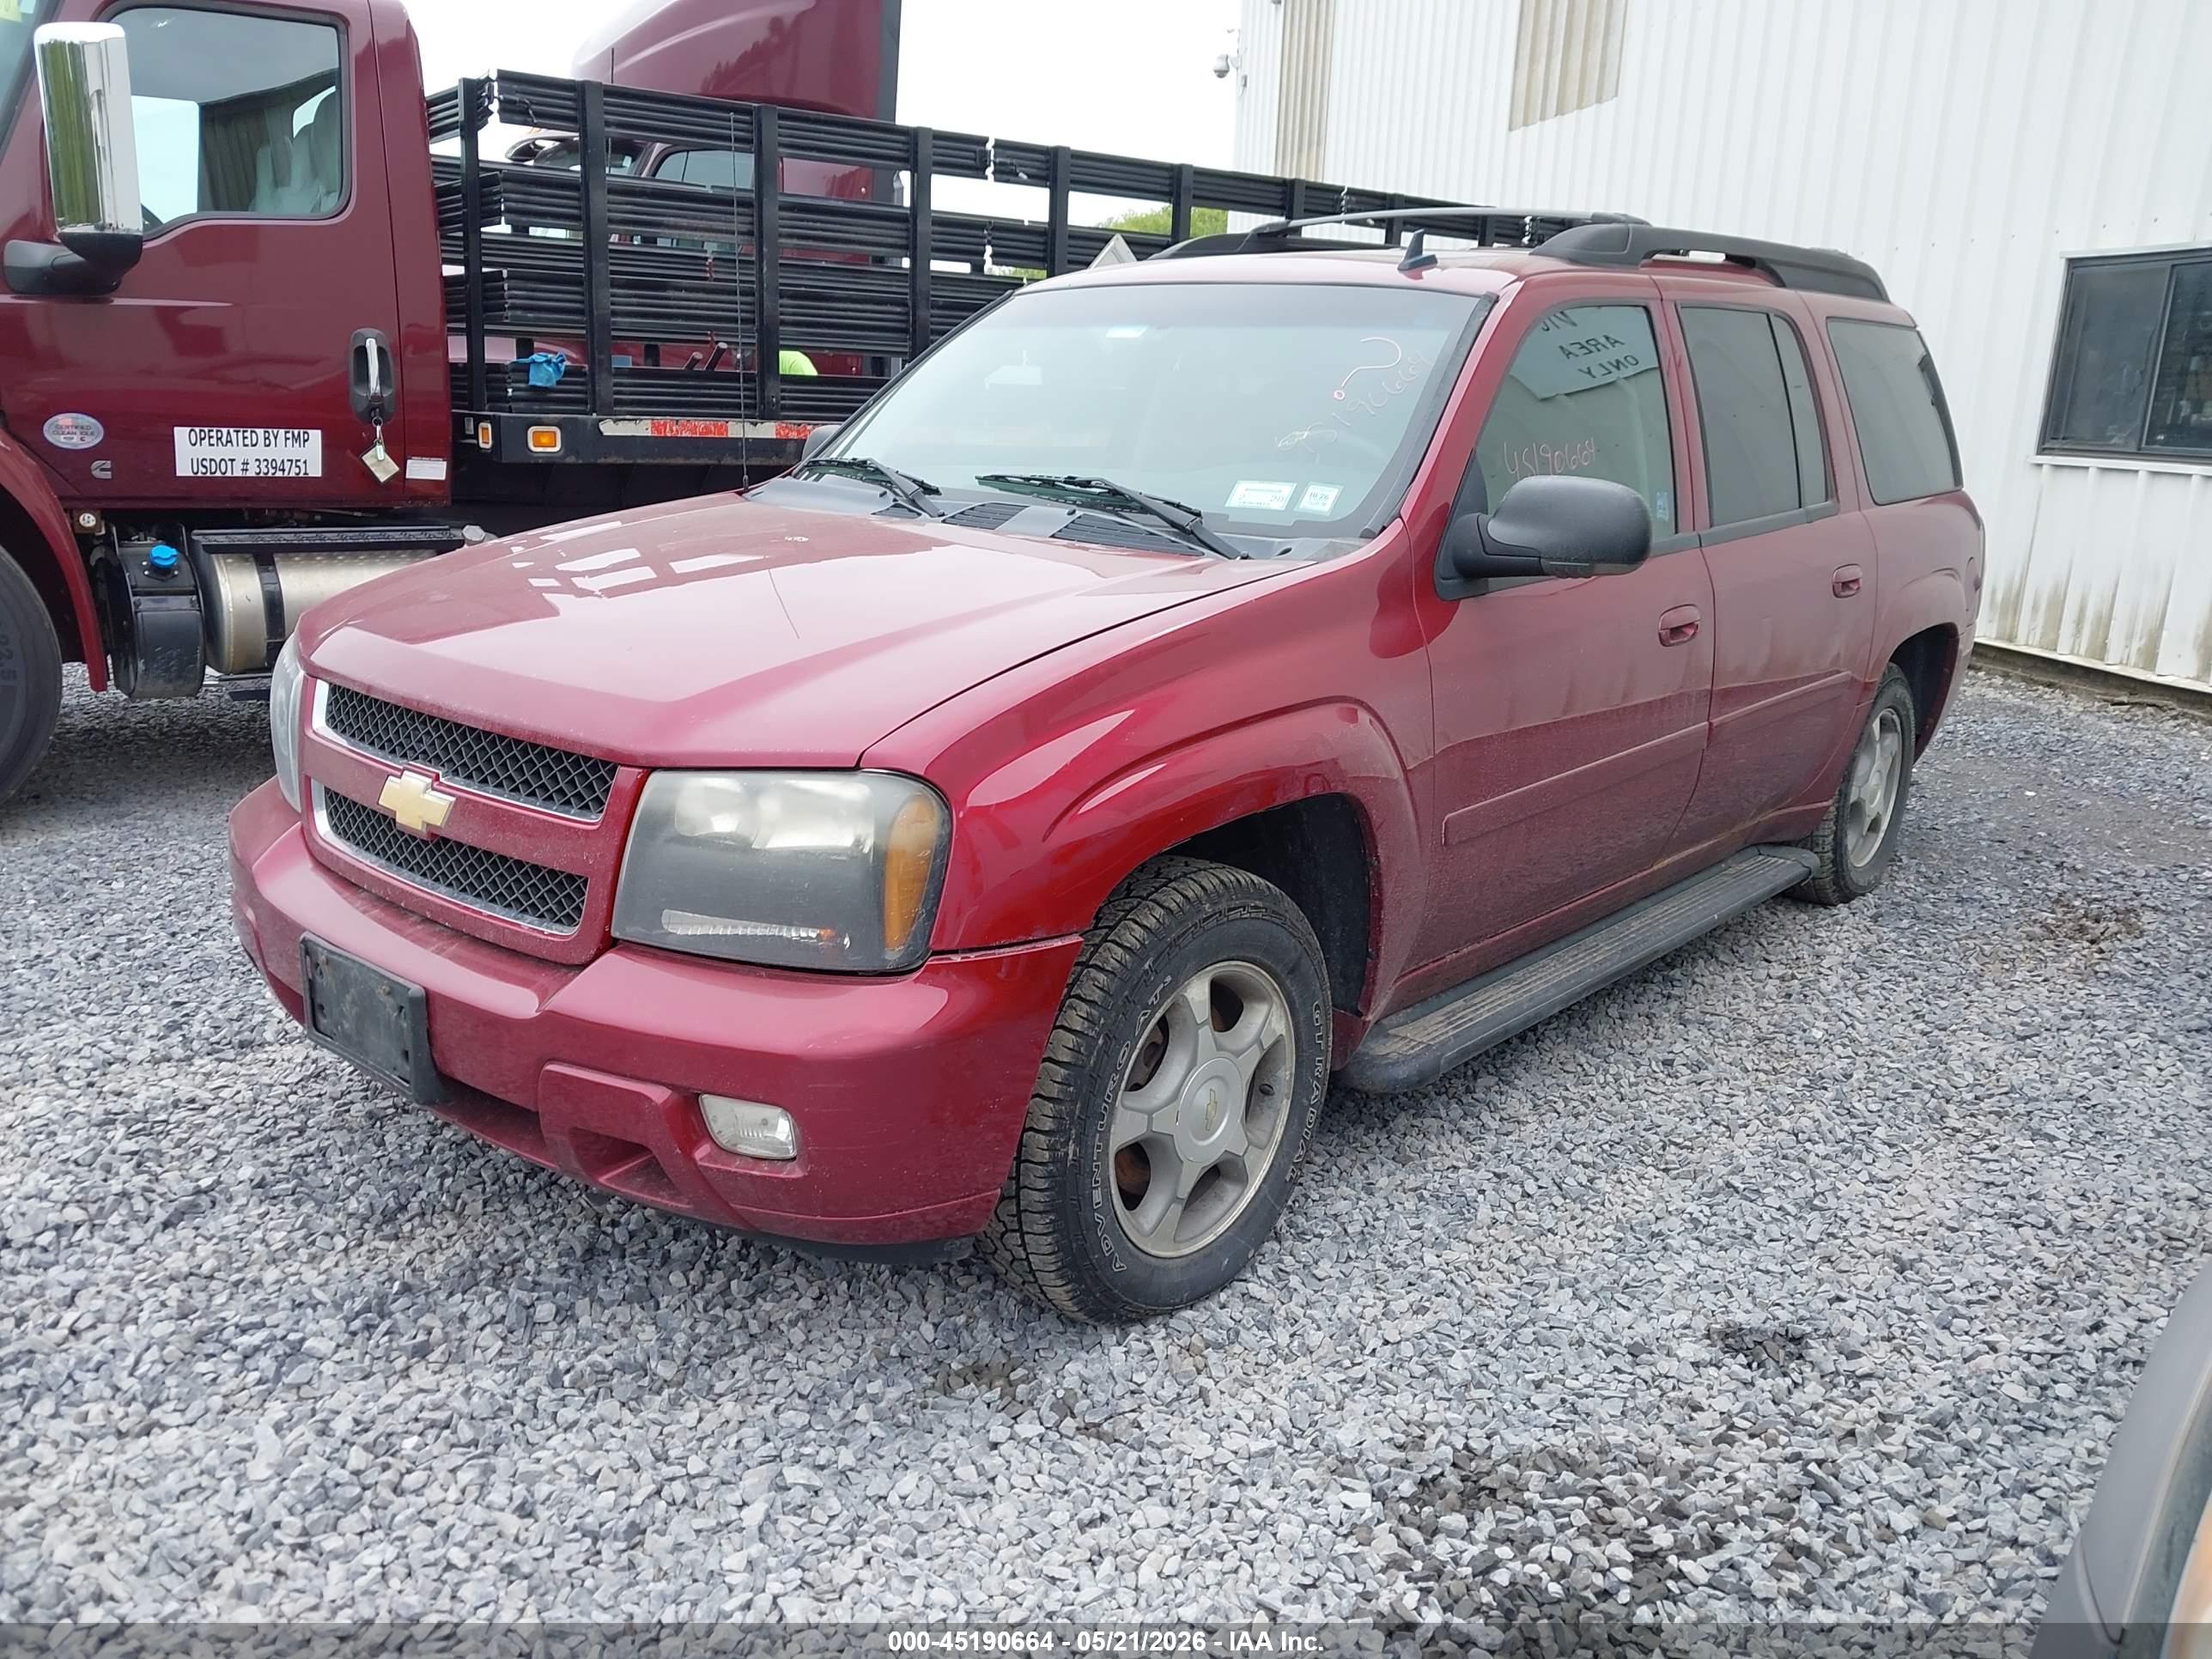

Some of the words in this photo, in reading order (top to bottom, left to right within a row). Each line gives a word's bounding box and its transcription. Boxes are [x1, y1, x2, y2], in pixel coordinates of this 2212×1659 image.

[188, 428, 259, 447] OPERATED
[263, 429, 279, 448] BY
[284, 430, 310, 448] FMP
[1504, 437, 1595, 481] 45190664
[191, 458, 236, 475] USDOT
[240, 458, 250, 475] #
[254, 459, 309, 476] 3394751
[1312, 1001, 1324, 1050] GT
[1285, 1057, 1324, 1182] RADIAL
[1091, 1040, 1131, 1272] ADVENTURO
